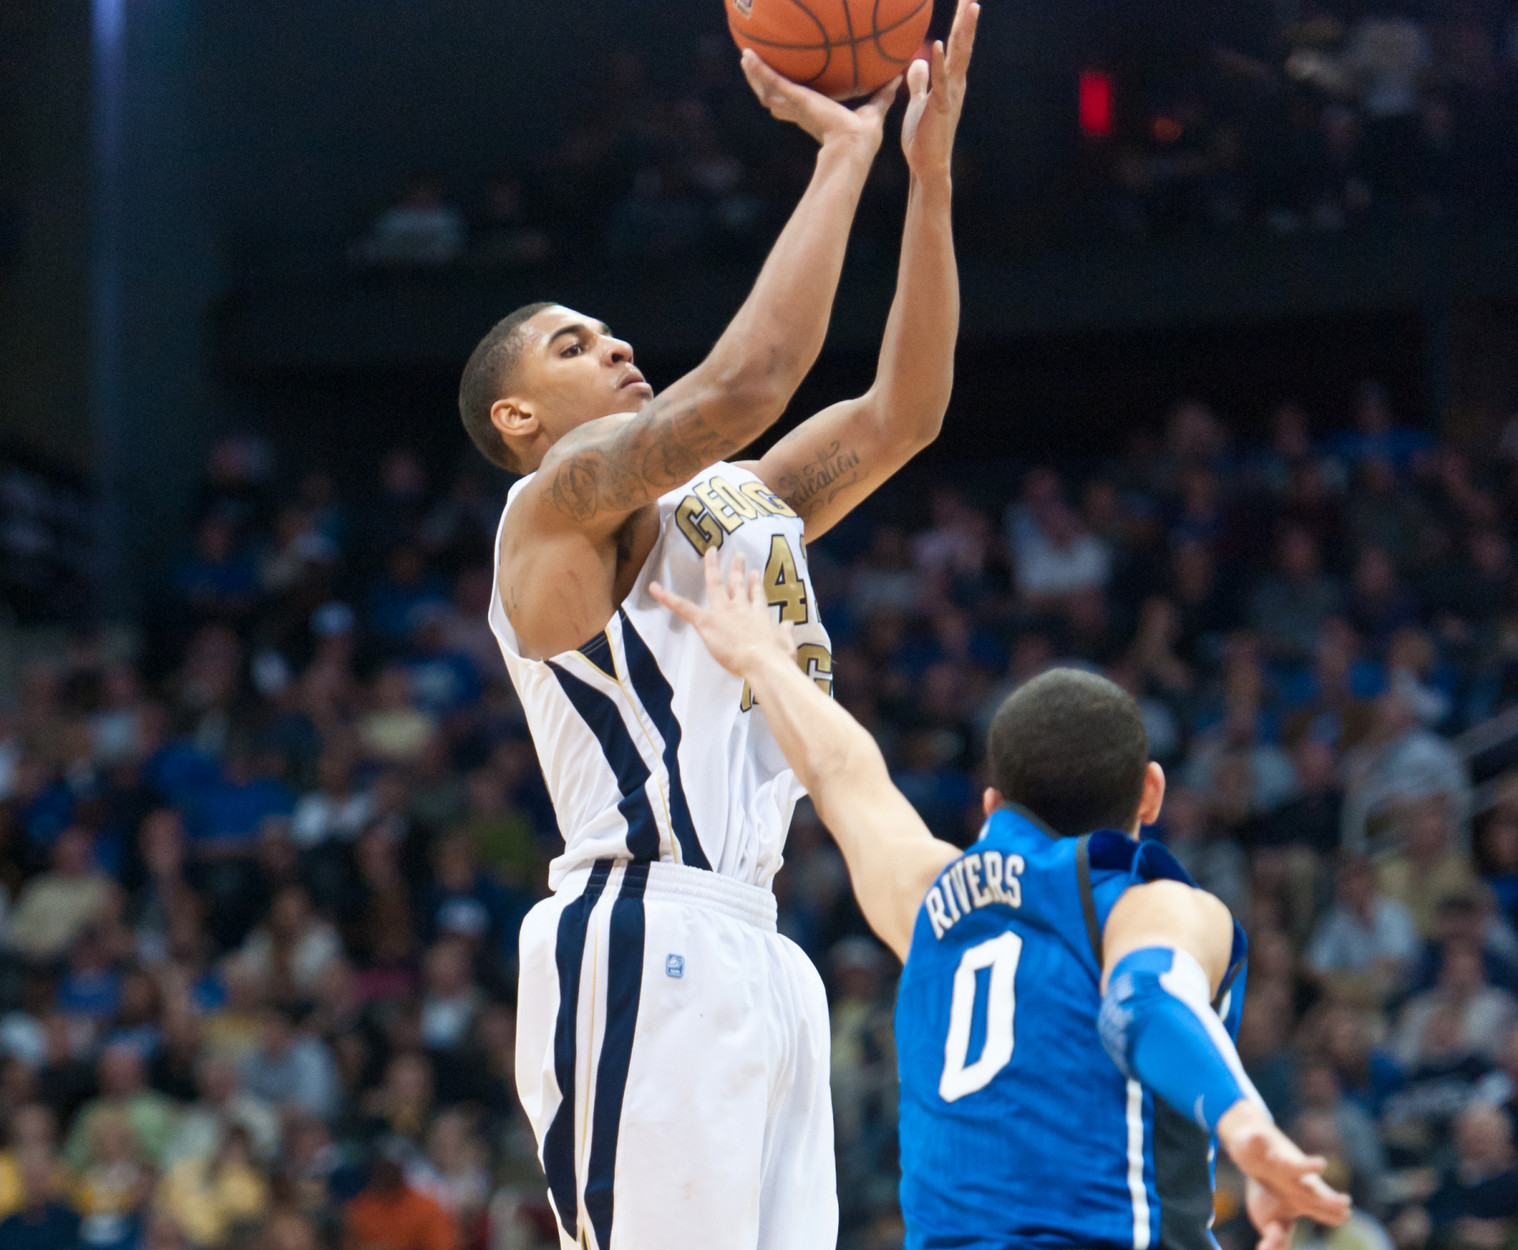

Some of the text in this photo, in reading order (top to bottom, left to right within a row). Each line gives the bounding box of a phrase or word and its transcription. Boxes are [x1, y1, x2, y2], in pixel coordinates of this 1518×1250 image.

[763, 533, 822, 626] 4
[925, 850, 1025, 940] RIVERS
[938, 929, 1023, 1103] 0
